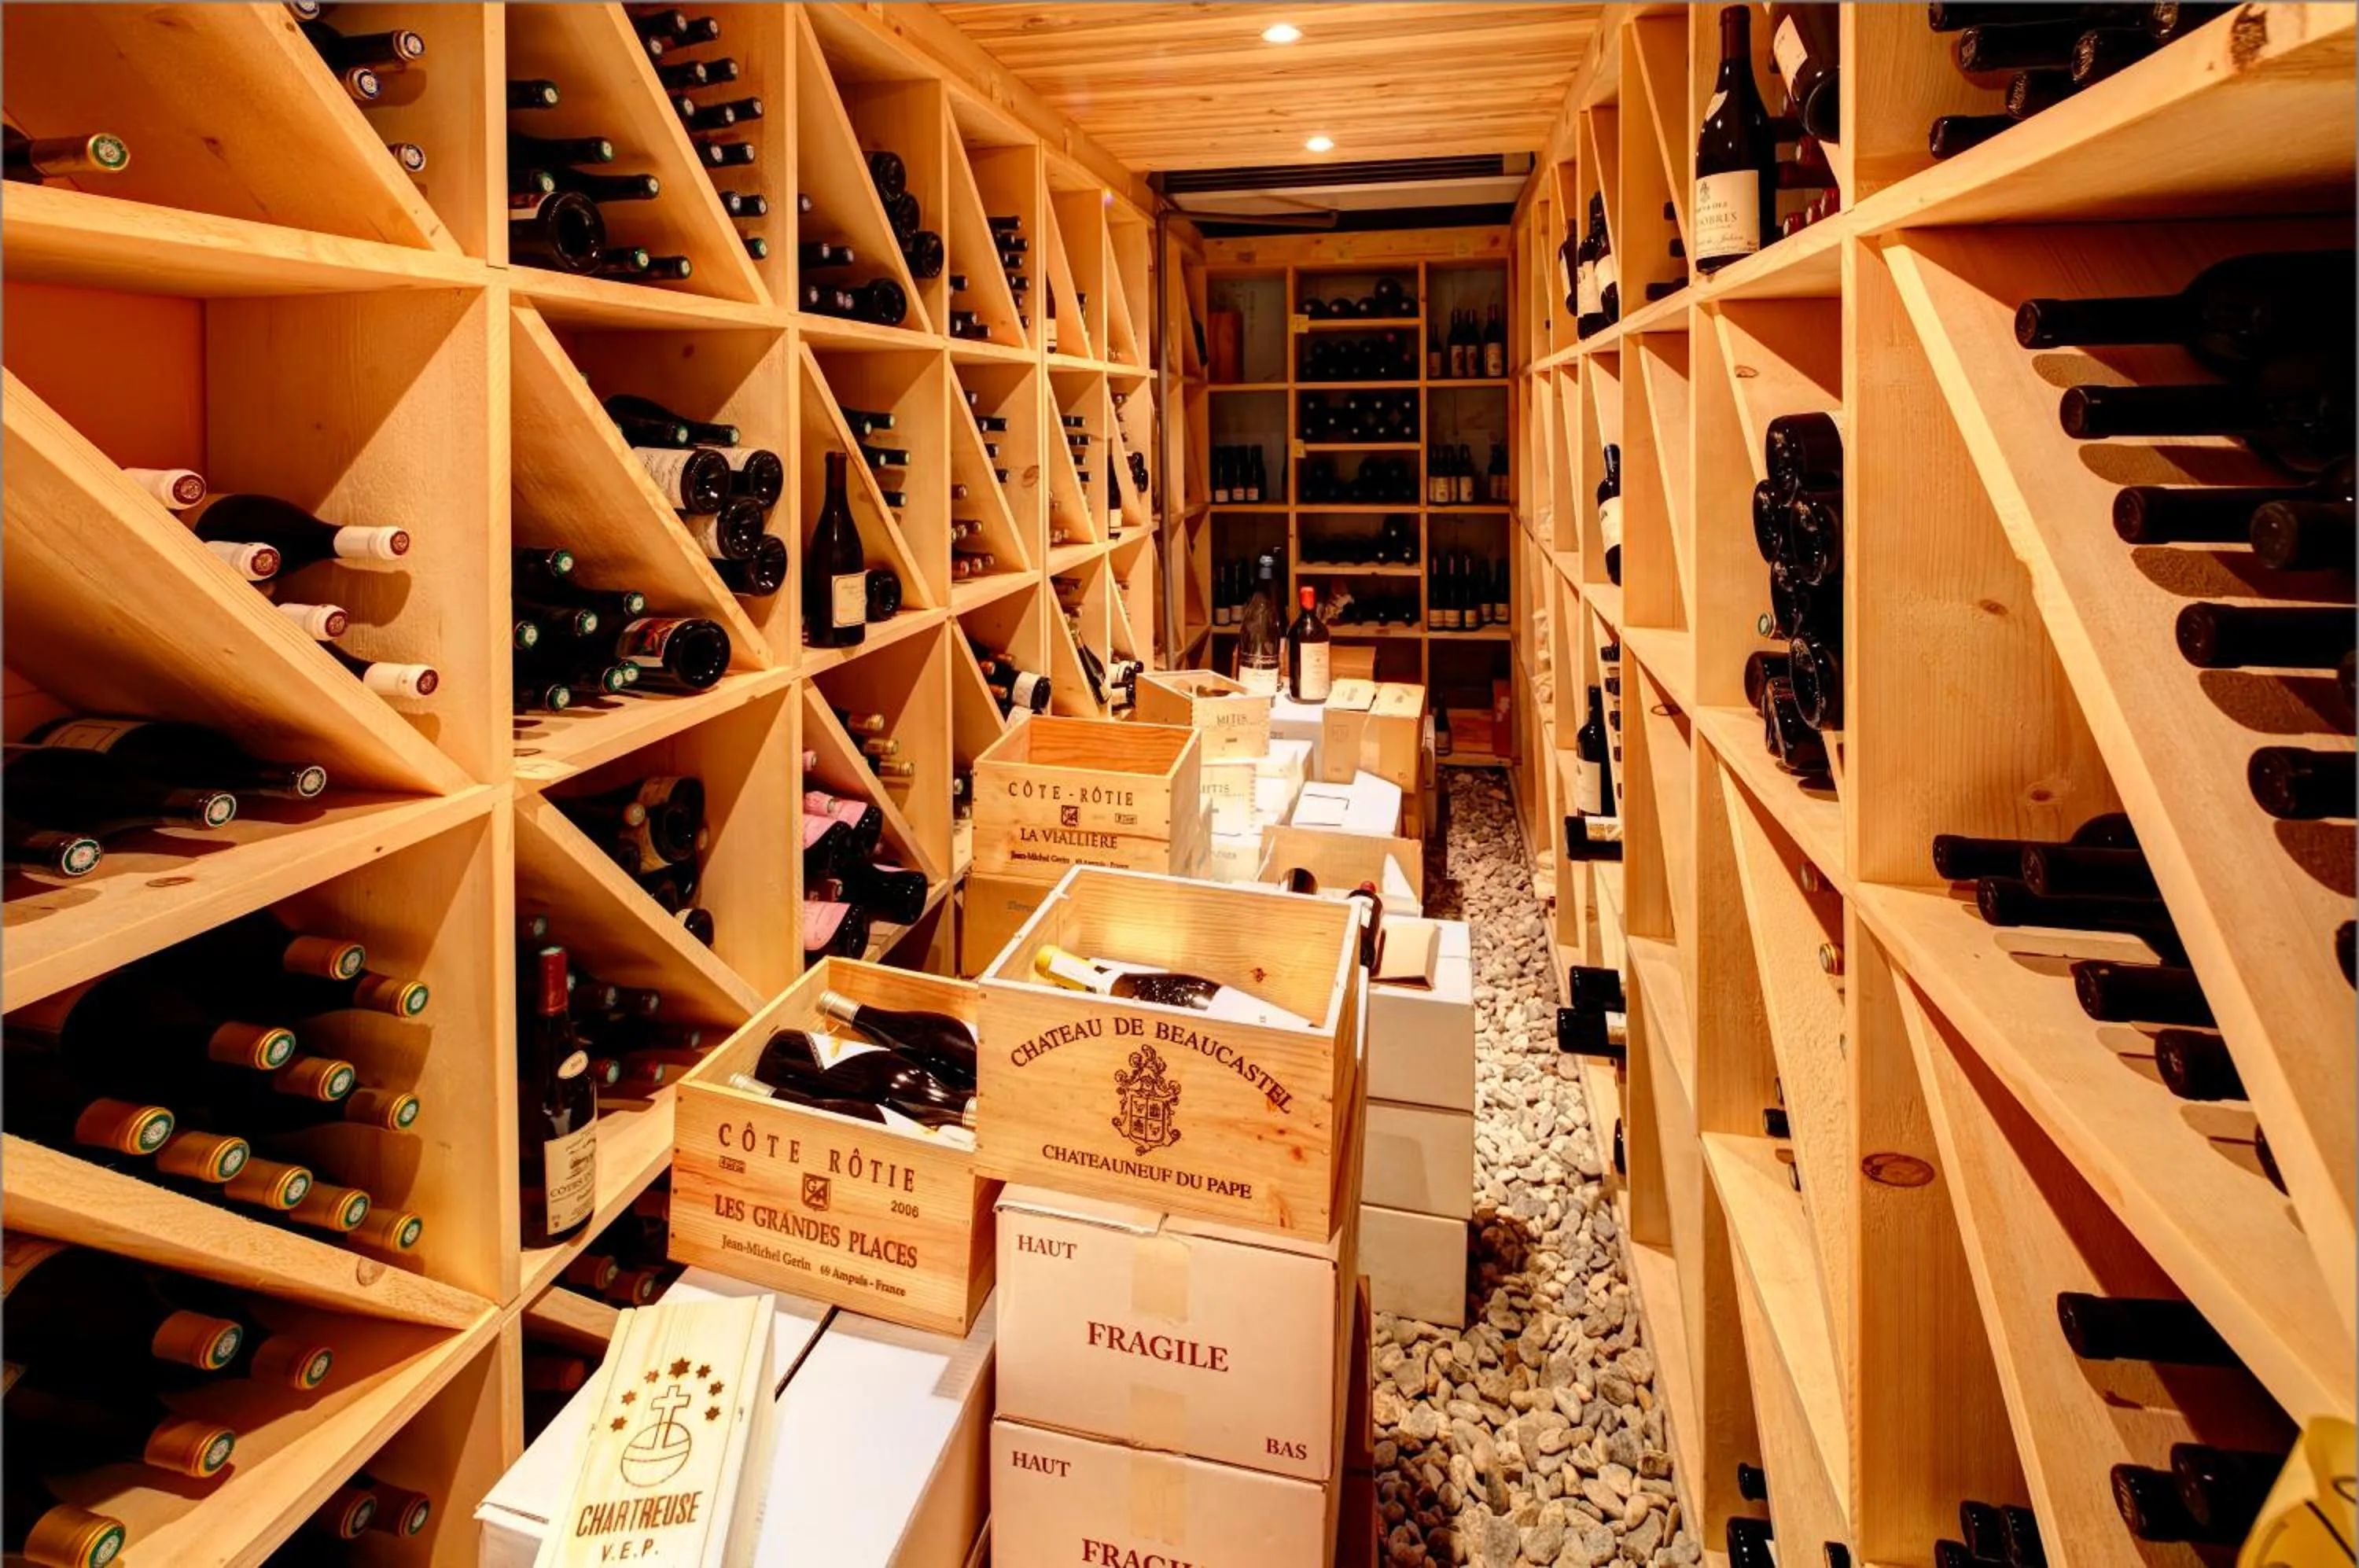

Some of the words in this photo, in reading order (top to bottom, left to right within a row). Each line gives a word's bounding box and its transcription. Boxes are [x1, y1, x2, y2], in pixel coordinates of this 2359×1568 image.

[1008, 780, 1061, 799] CÔTE
[1080, 786, 1133, 806] RÔTIE
[1021, 828, 1038, 842] LA
[1011, 1018, 1102, 1068] CHATEAU
[1114, 1018, 1144, 1036] DE
[1156, 1021, 1294, 1114] BEAUCASTEL
[719, 1122, 800, 1164] CÔTE
[830, 1147, 915, 1193] RÔTIE
[1042, 1143, 1172, 1183] CHATEAUNEUF
[1176, 1171, 1202, 1189] DU
[1207, 1177, 1253, 1199] PAPE
[891, 1199, 919, 1217] 2006
[714, 1194, 745, 1222] LES
[753, 1205, 841, 1248] GRANDES
[848, 1230, 918, 1269] PLACES
[1018, 1234, 1077, 1260] HAUT
[721, 1234, 781, 1262] Jean-Michel
[782, 1252, 811, 1272] Gerin
[875, 1279, 907, 1297] France
[1087, 1321, 1229, 1372] FRAGILE
[1266, 1437, 1307, 1461] BAS
[1011, 1451, 1071, 1478] HAUT
[576, 1491, 703, 1537] CHARTREUSE
[600, 1538, 659, 1562] V.E.P.
[1081, 1537, 1207, 1567] FRAG
